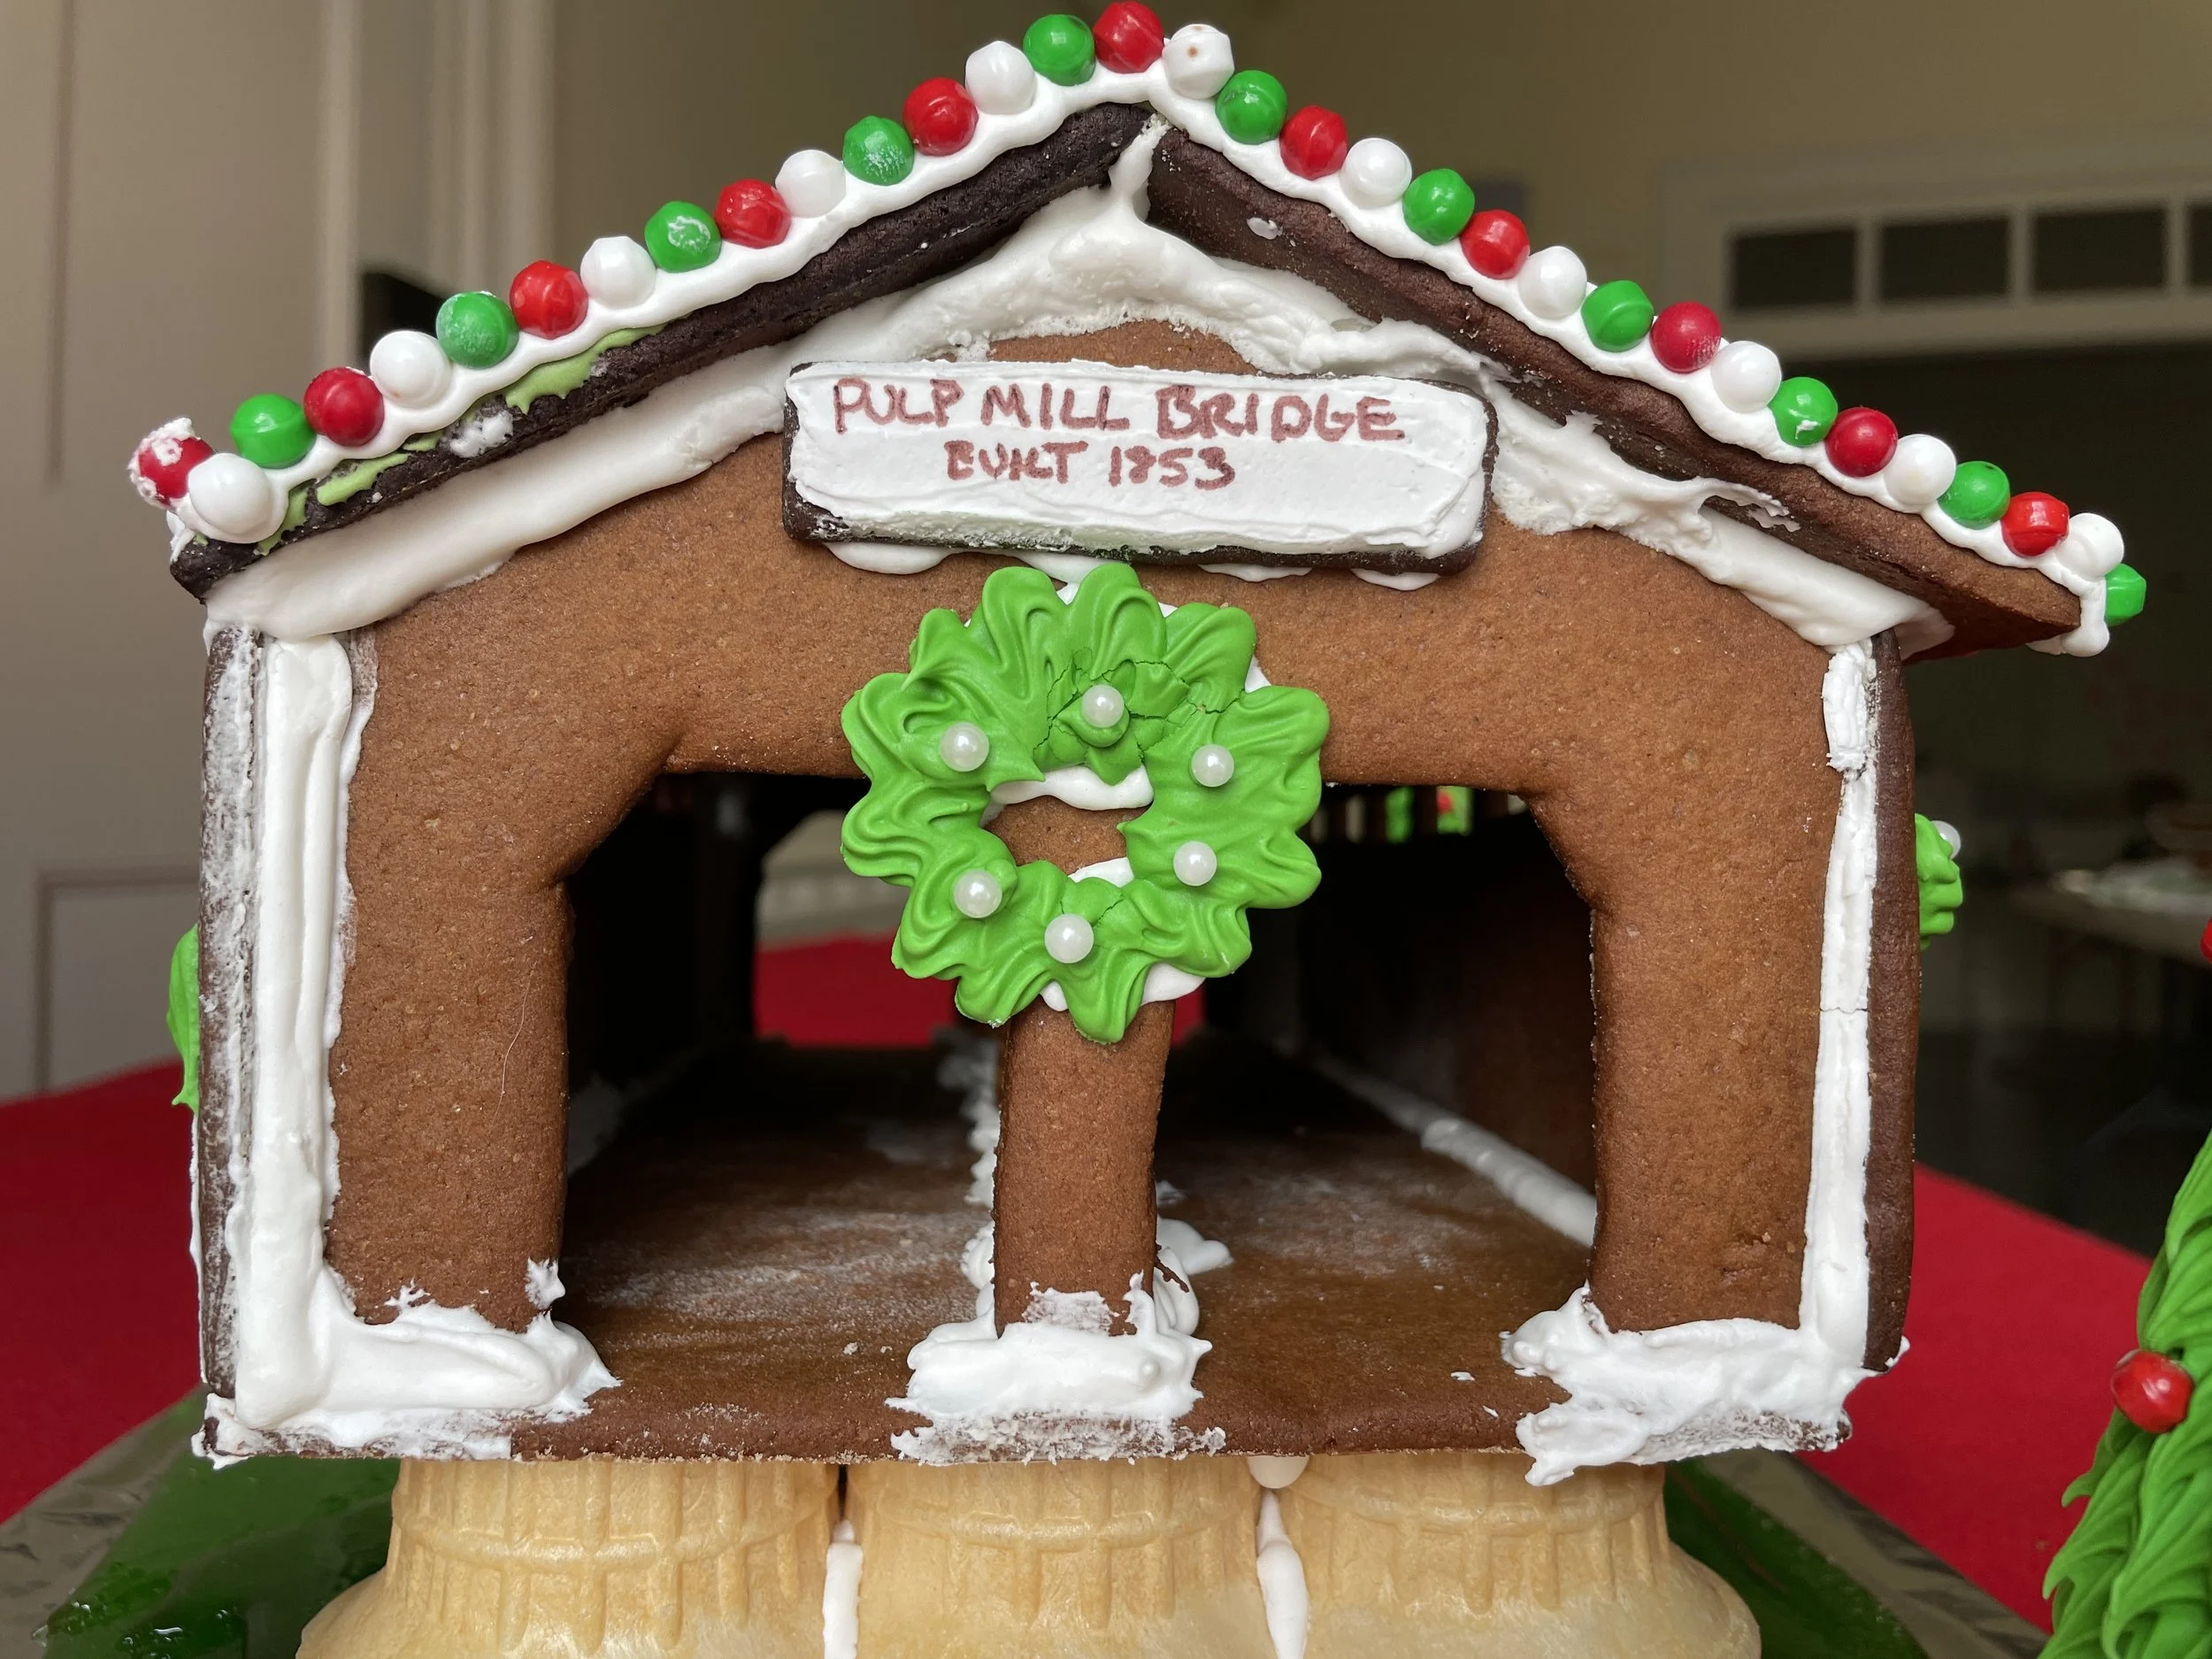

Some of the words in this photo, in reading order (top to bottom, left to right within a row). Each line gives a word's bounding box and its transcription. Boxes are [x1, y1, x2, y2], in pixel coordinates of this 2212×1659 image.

[833, 377, 964, 434] PULP
[981, 382, 1130, 429] MILL
[1156, 385, 1404, 443] BRIDGE
[943, 440, 1088, 484] BUILT
[1109, 445, 1235, 490] 1853
